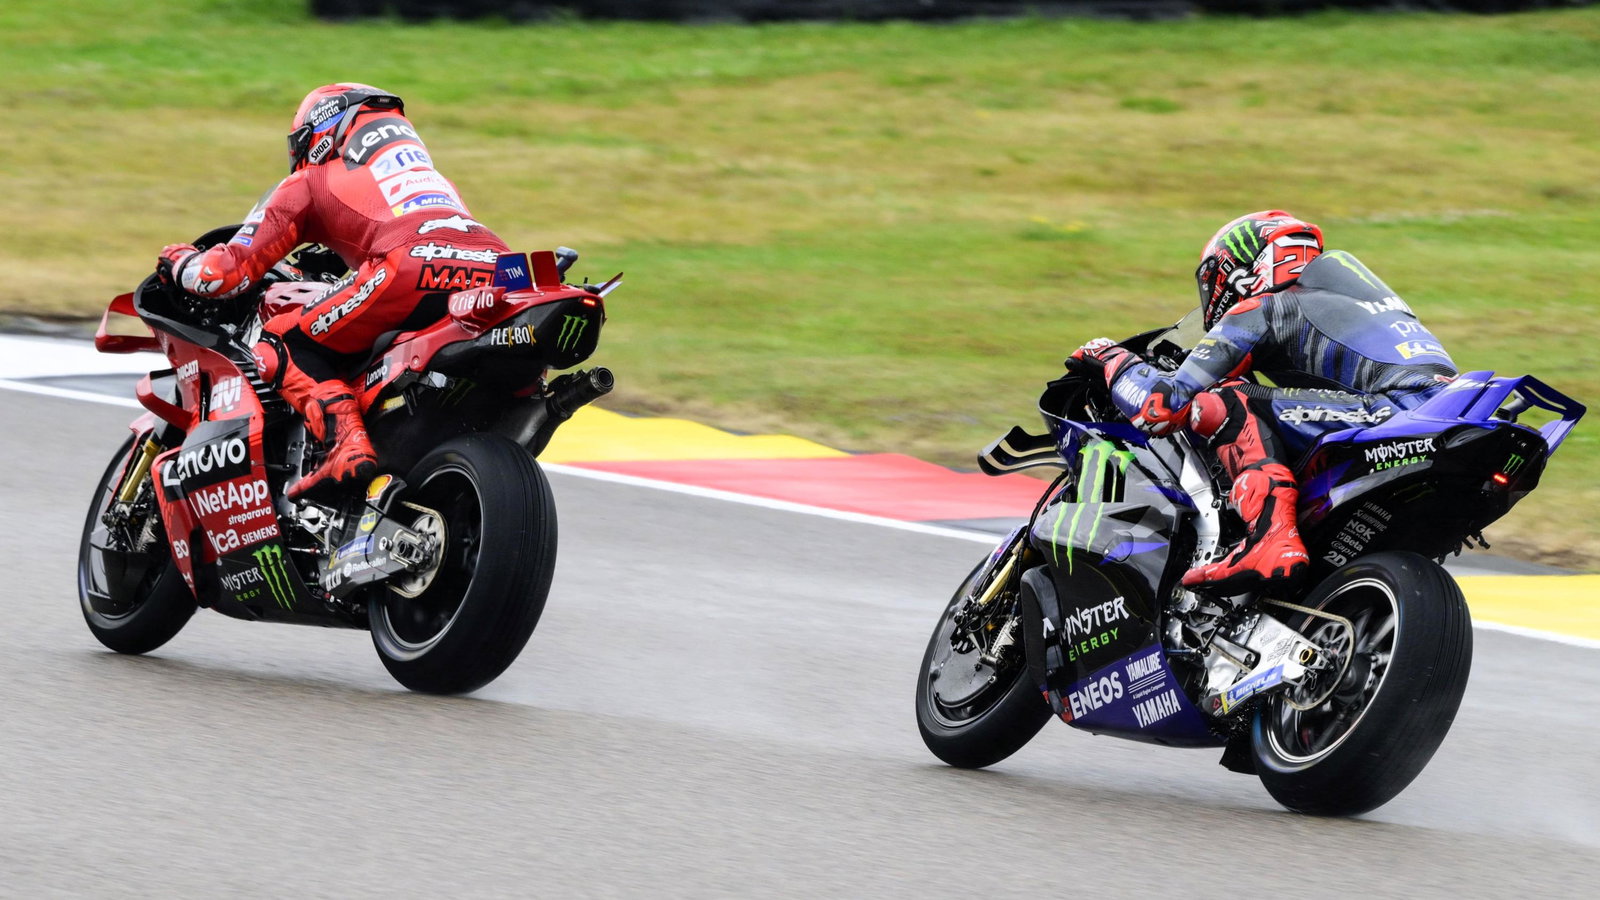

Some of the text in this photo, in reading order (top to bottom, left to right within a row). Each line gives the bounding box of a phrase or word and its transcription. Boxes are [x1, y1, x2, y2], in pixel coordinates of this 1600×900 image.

[312, 105, 340, 126] Galicia
[310, 138, 331, 161] SHOEI
[347, 124, 418, 163] Leno
[505, 265, 524, 281] TIM
[310, 267, 387, 336] alpinestars
[490, 323, 537, 349] FLEX-BOX
[366, 364, 388, 386] Lenovo
[162, 437, 246, 487] Lenovo
[1364, 437, 1437, 464] MONSTER
[1375, 454, 1428, 471] ENERGY
[194, 478, 269, 517] NetApp
[227, 506, 272, 526] streparava
[241, 524, 278, 546] SIEMENS
[1345, 518, 1376, 541] NGK
[1342, 534, 1364, 552] Beta
[1322, 550, 1348, 568] 2D
[1125, 650, 1162, 683] YAMALUBE
[1068, 670, 1124, 721] ENEOS
[1131, 688, 1182, 729] YAMAHA
